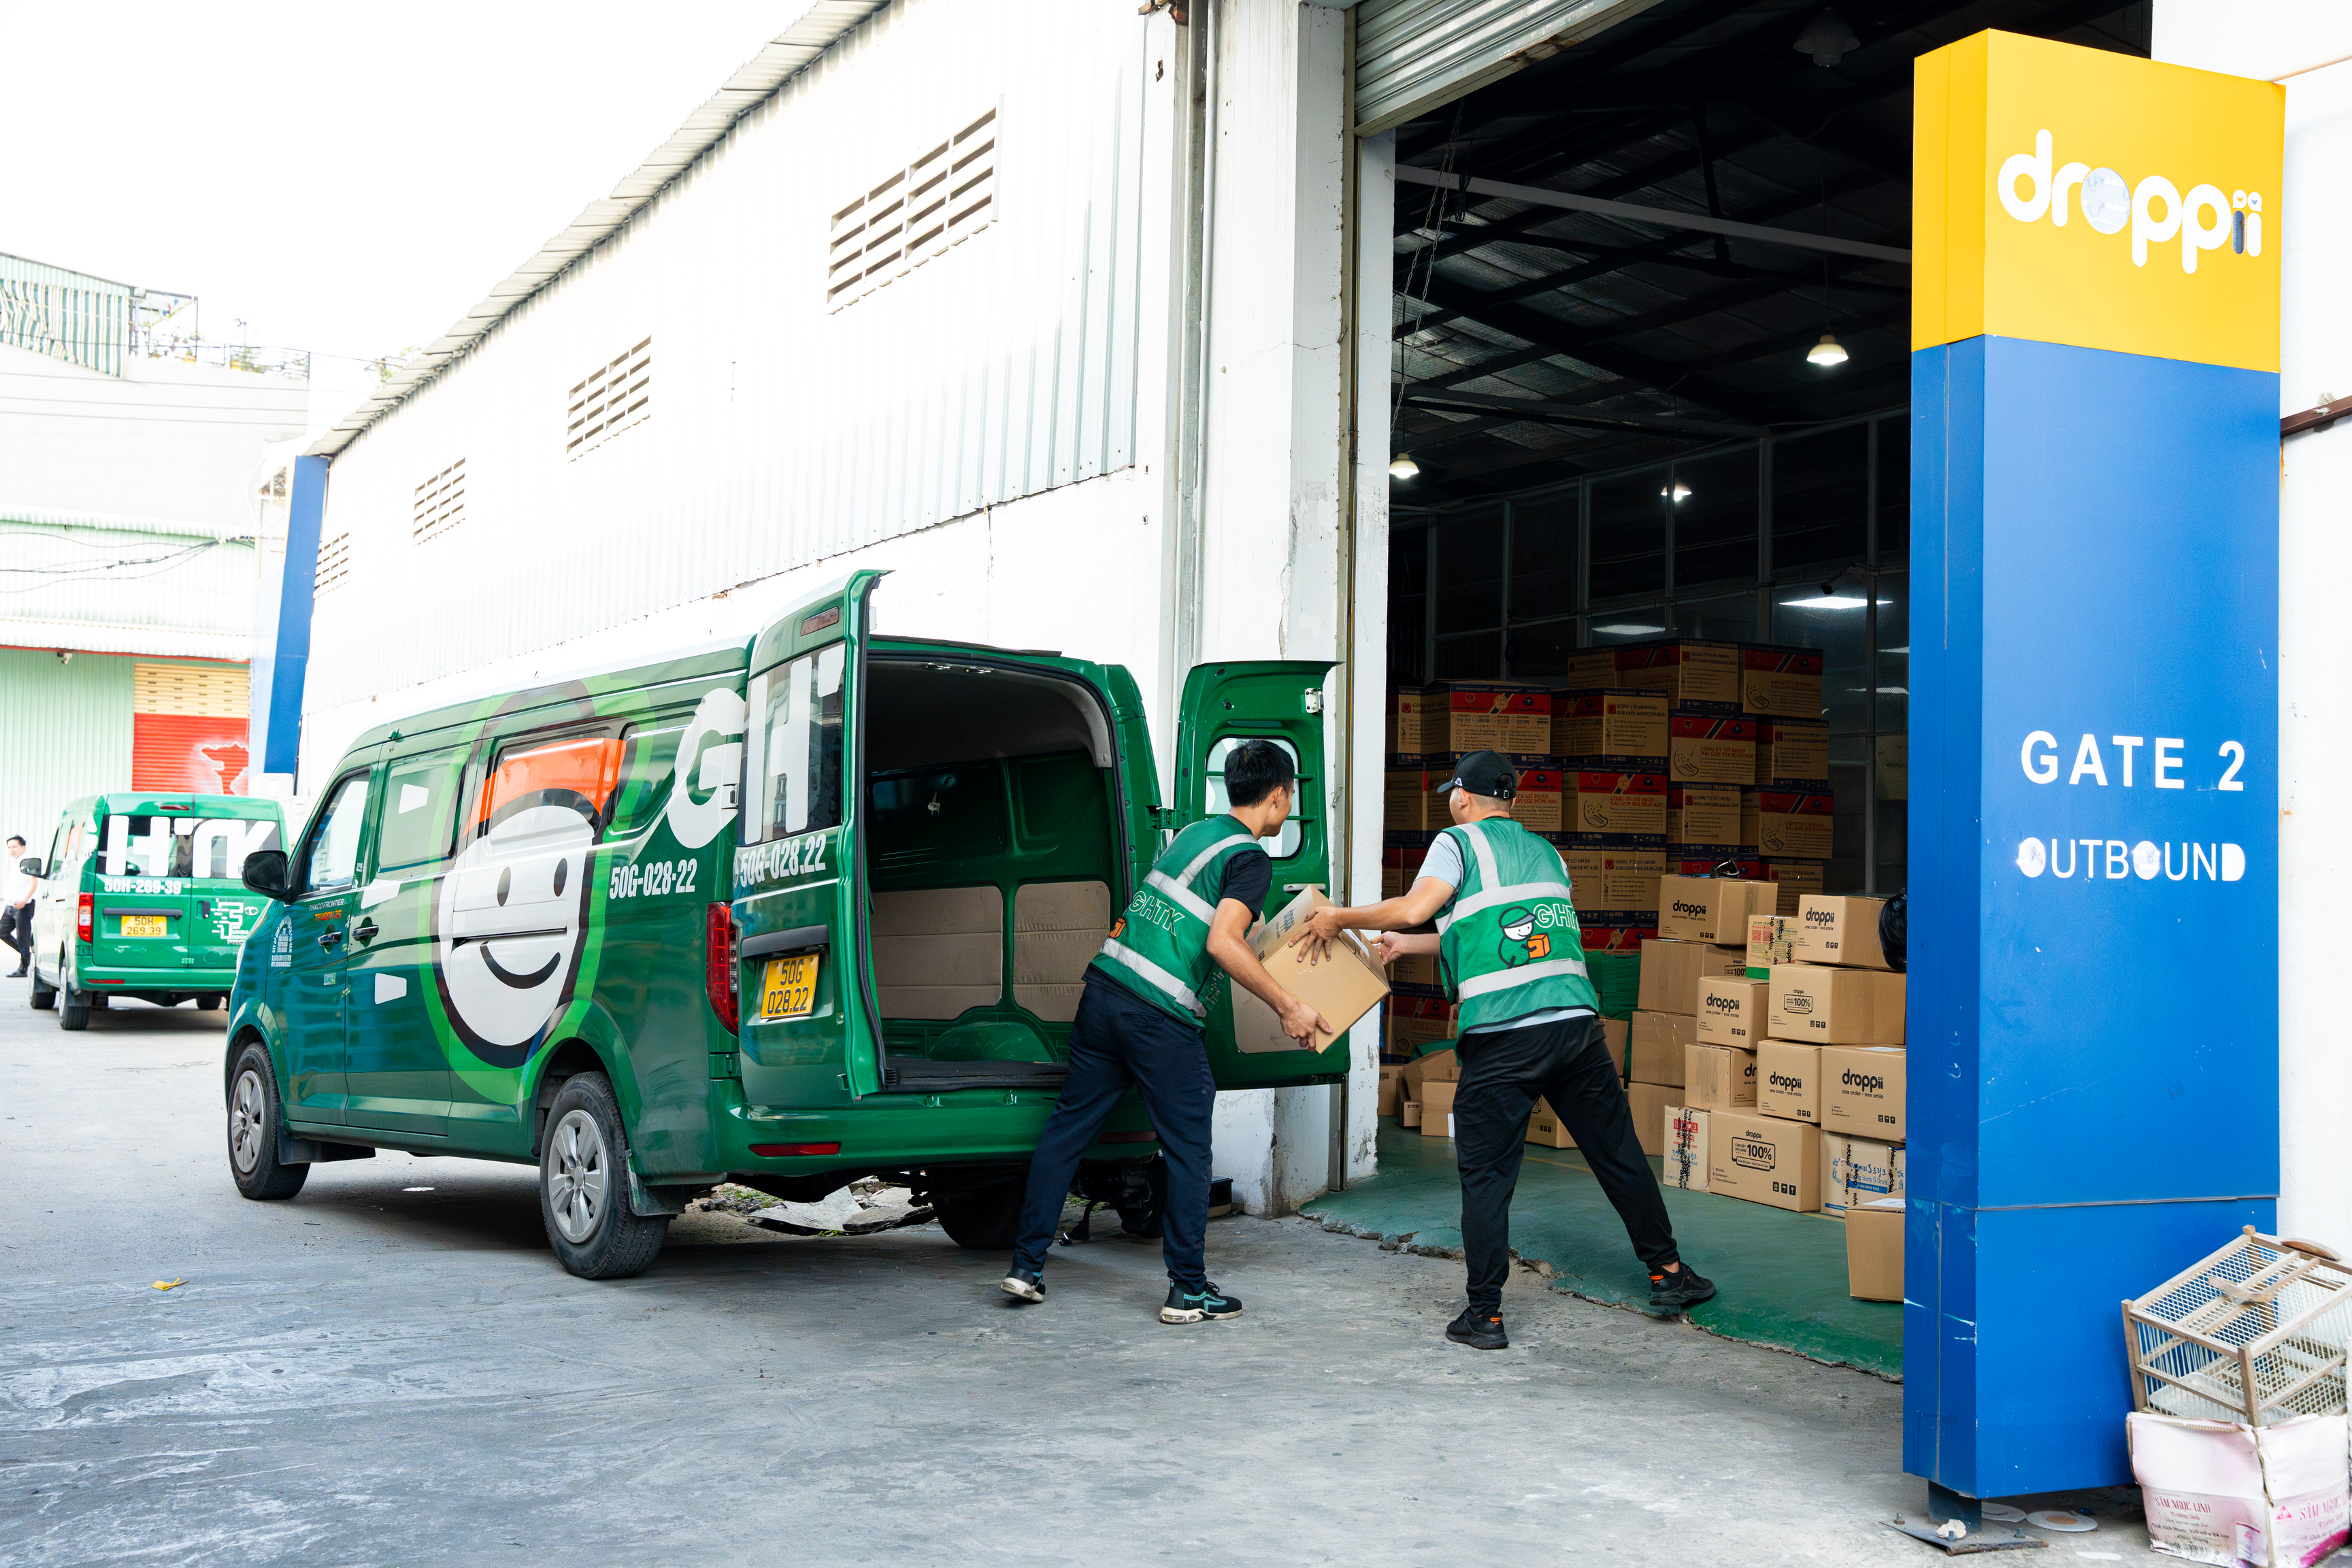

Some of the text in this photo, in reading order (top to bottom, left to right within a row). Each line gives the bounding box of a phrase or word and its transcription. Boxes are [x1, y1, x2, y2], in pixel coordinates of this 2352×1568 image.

[1998, 129, 2262, 274] droppii
[2021, 730, 2245, 791] GATE 2
[740, 833, 827, 887] 50G-028.22
[2017, 837, 2246, 882] OUTBOUND
[104, 878, 182, 895] 50H-269-39
[322, 899, 344, 909] FRONTIER
[1129, 890, 1185, 937] GHTK
[1672, 899, 1706, 917] droppii
[135, 917, 154, 925] 50H
[1533, 903, 1580, 931] GHT
[1806, 907, 1835, 926] droppii
[127, 927, 161, 935] 269.39
[780, 961, 803, 986] 50G
[767, 986, 809, 1015] 028.22
[1706, 992, 1740, 1013] droppii
[1794, 997, 1810, 1007] 100%
[1770, 1071, 1802, 1091] droppii
[1842, 1068, 1883, 1092] droppii
[1746, 1144, 1772, 1161] 100%
[2154, 1495, 2170, 1509] SÂM
[2193, 1501, 2212, 1514] LINH
